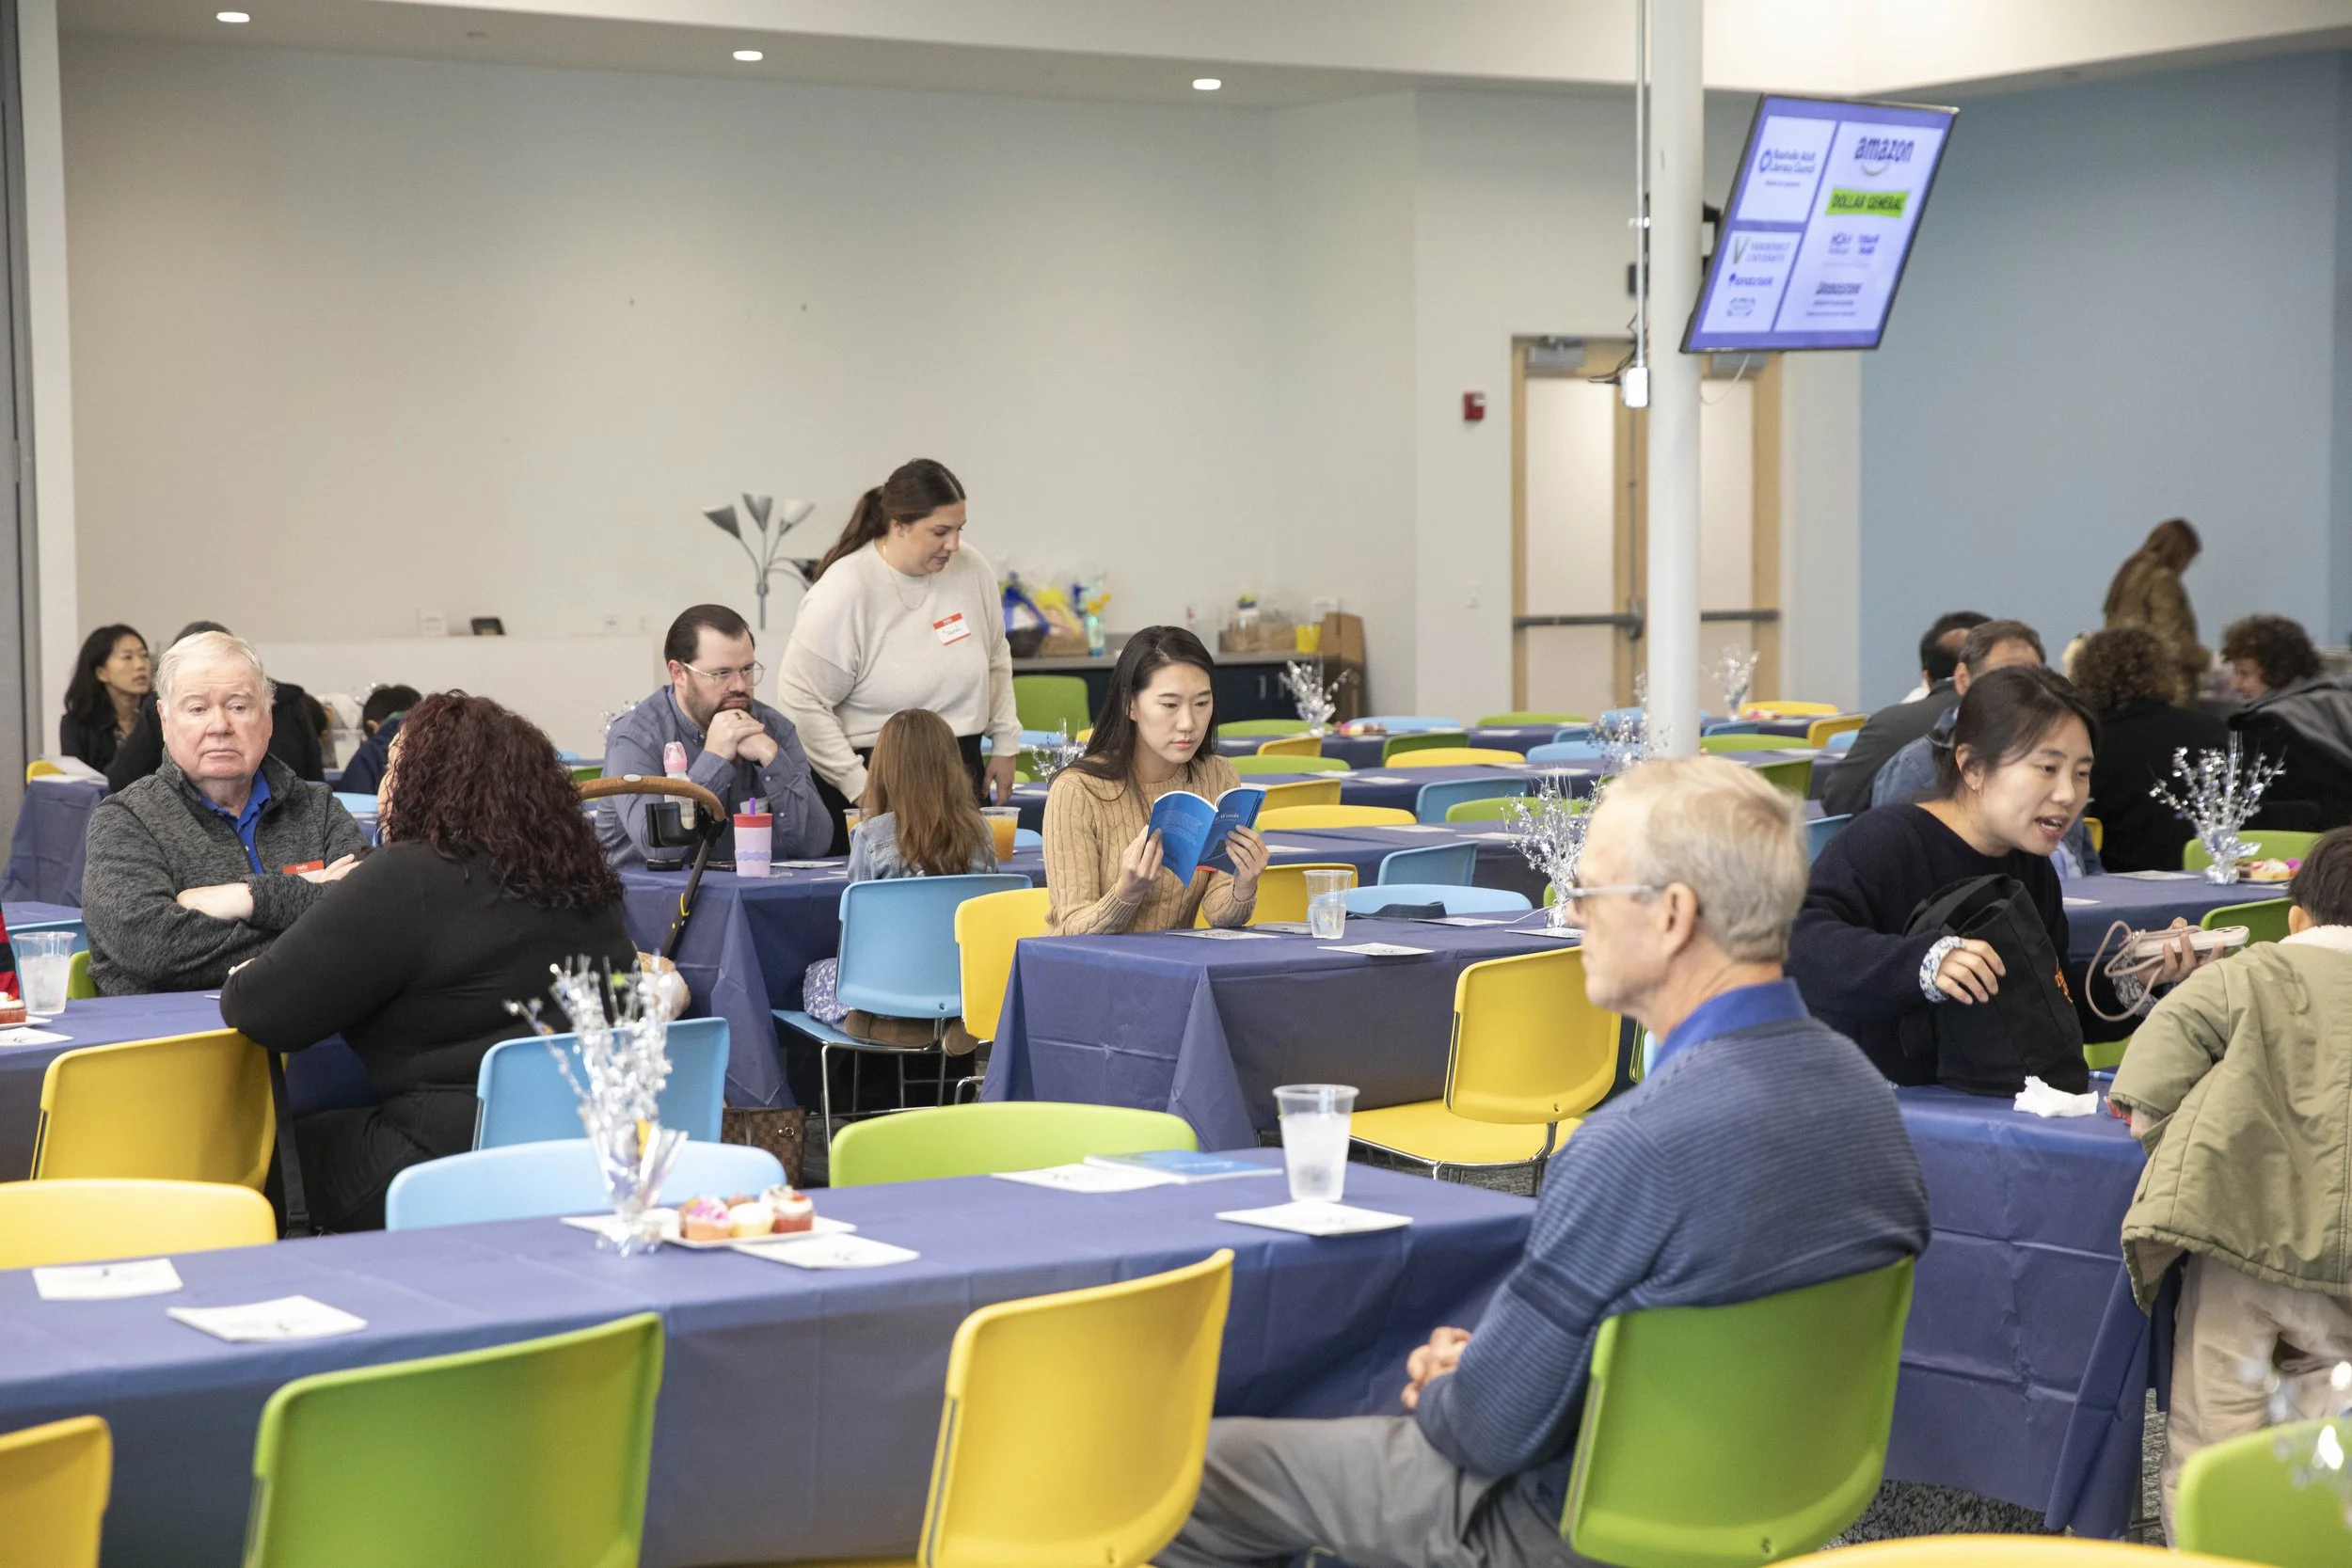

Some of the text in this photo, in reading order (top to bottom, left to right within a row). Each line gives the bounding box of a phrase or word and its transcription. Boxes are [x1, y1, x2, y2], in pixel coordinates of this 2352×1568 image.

[1854, 136, 1915, 162] amazon
[1832, 194, 1902, 211] DOLLAR GENERAL
